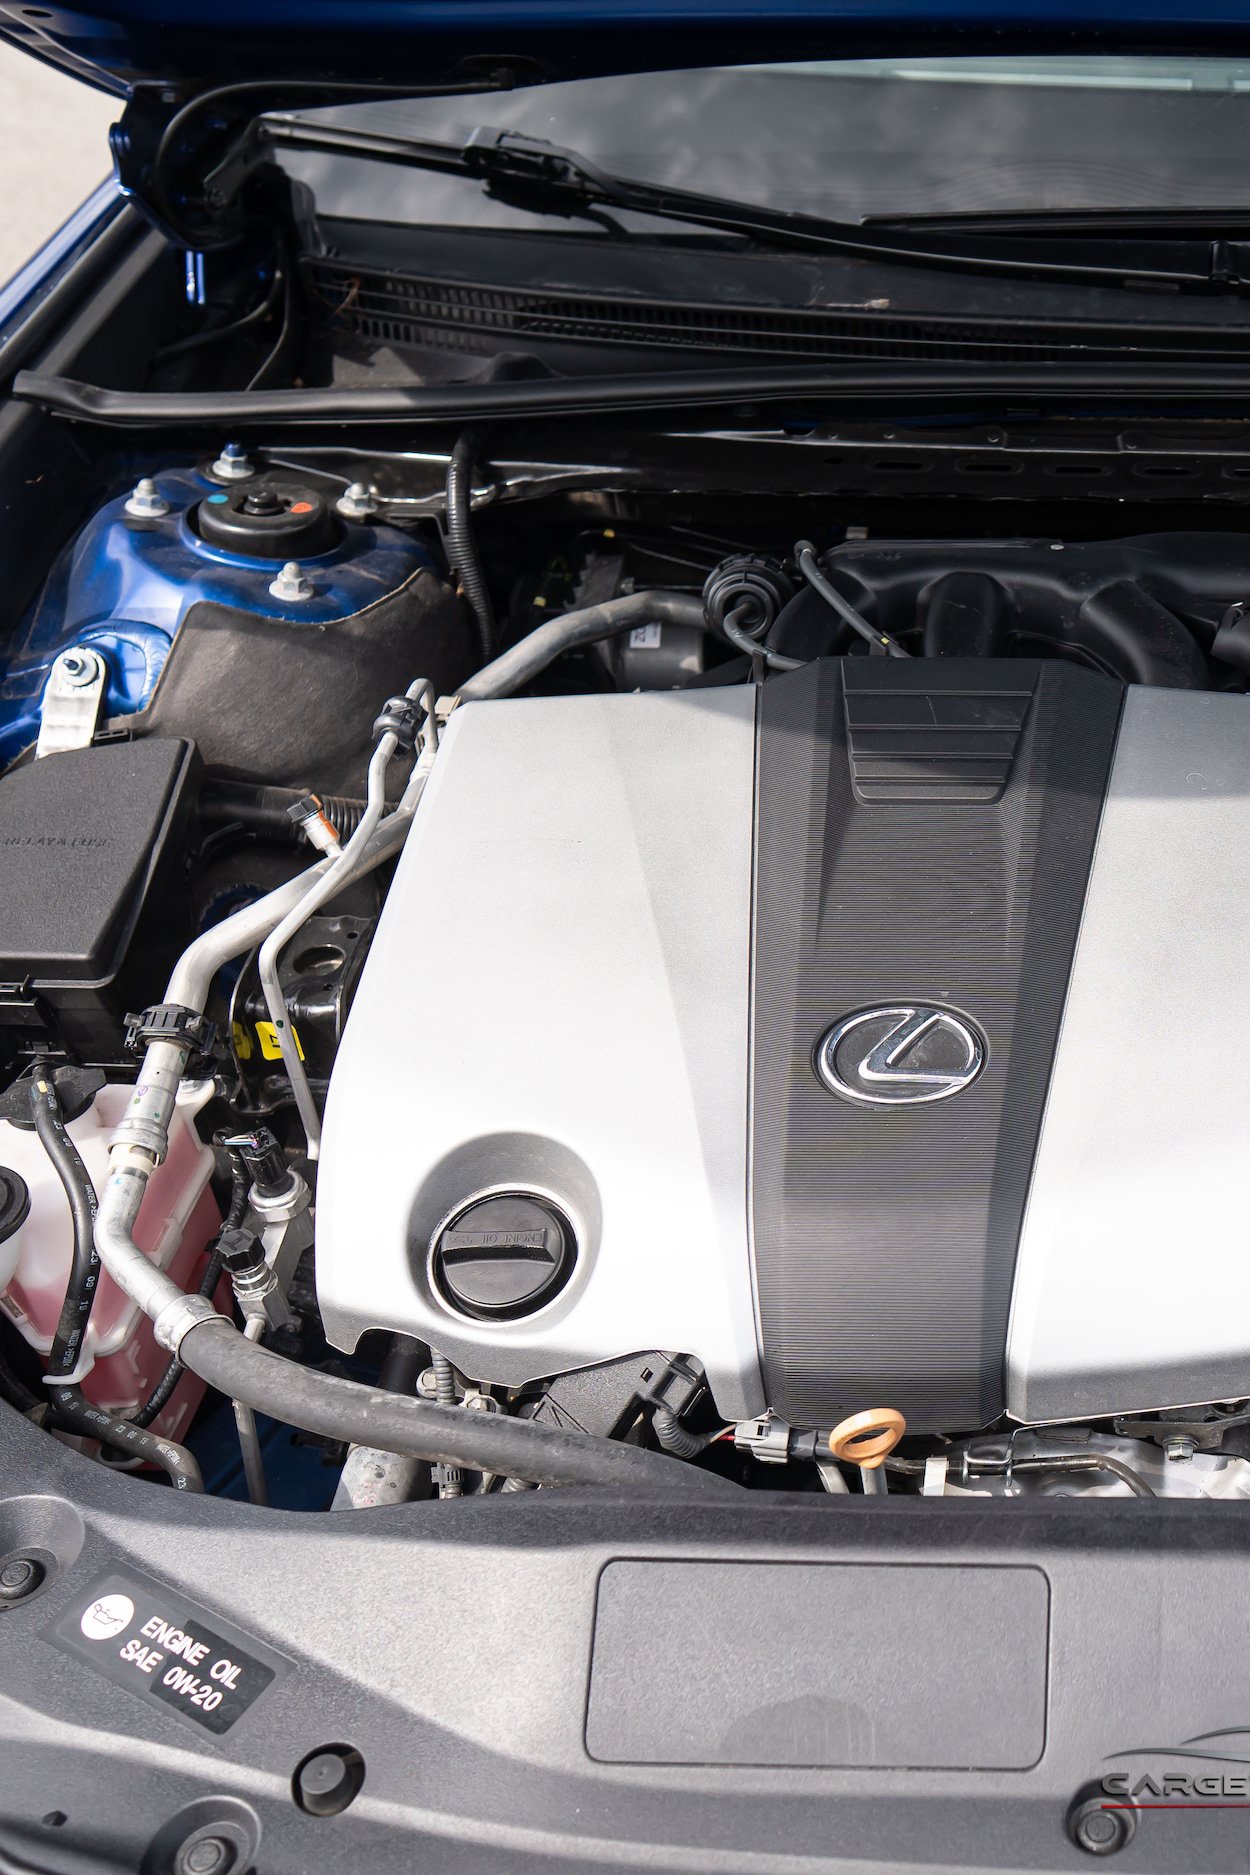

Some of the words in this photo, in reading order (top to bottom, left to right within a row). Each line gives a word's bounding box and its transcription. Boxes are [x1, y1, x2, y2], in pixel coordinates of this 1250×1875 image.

[482, 1234, 497, 1244] OIL
[79, 1300, 89, 1311] 19
[68, 1329, 81, 1347] WATER
[140, 1616, 211, 1667] ENGINE
[209, 1659, 242, 1690] OIL
[119, 1639, 164, 1673] SAE
[162, 1666, 223, 1712] 0W-20
